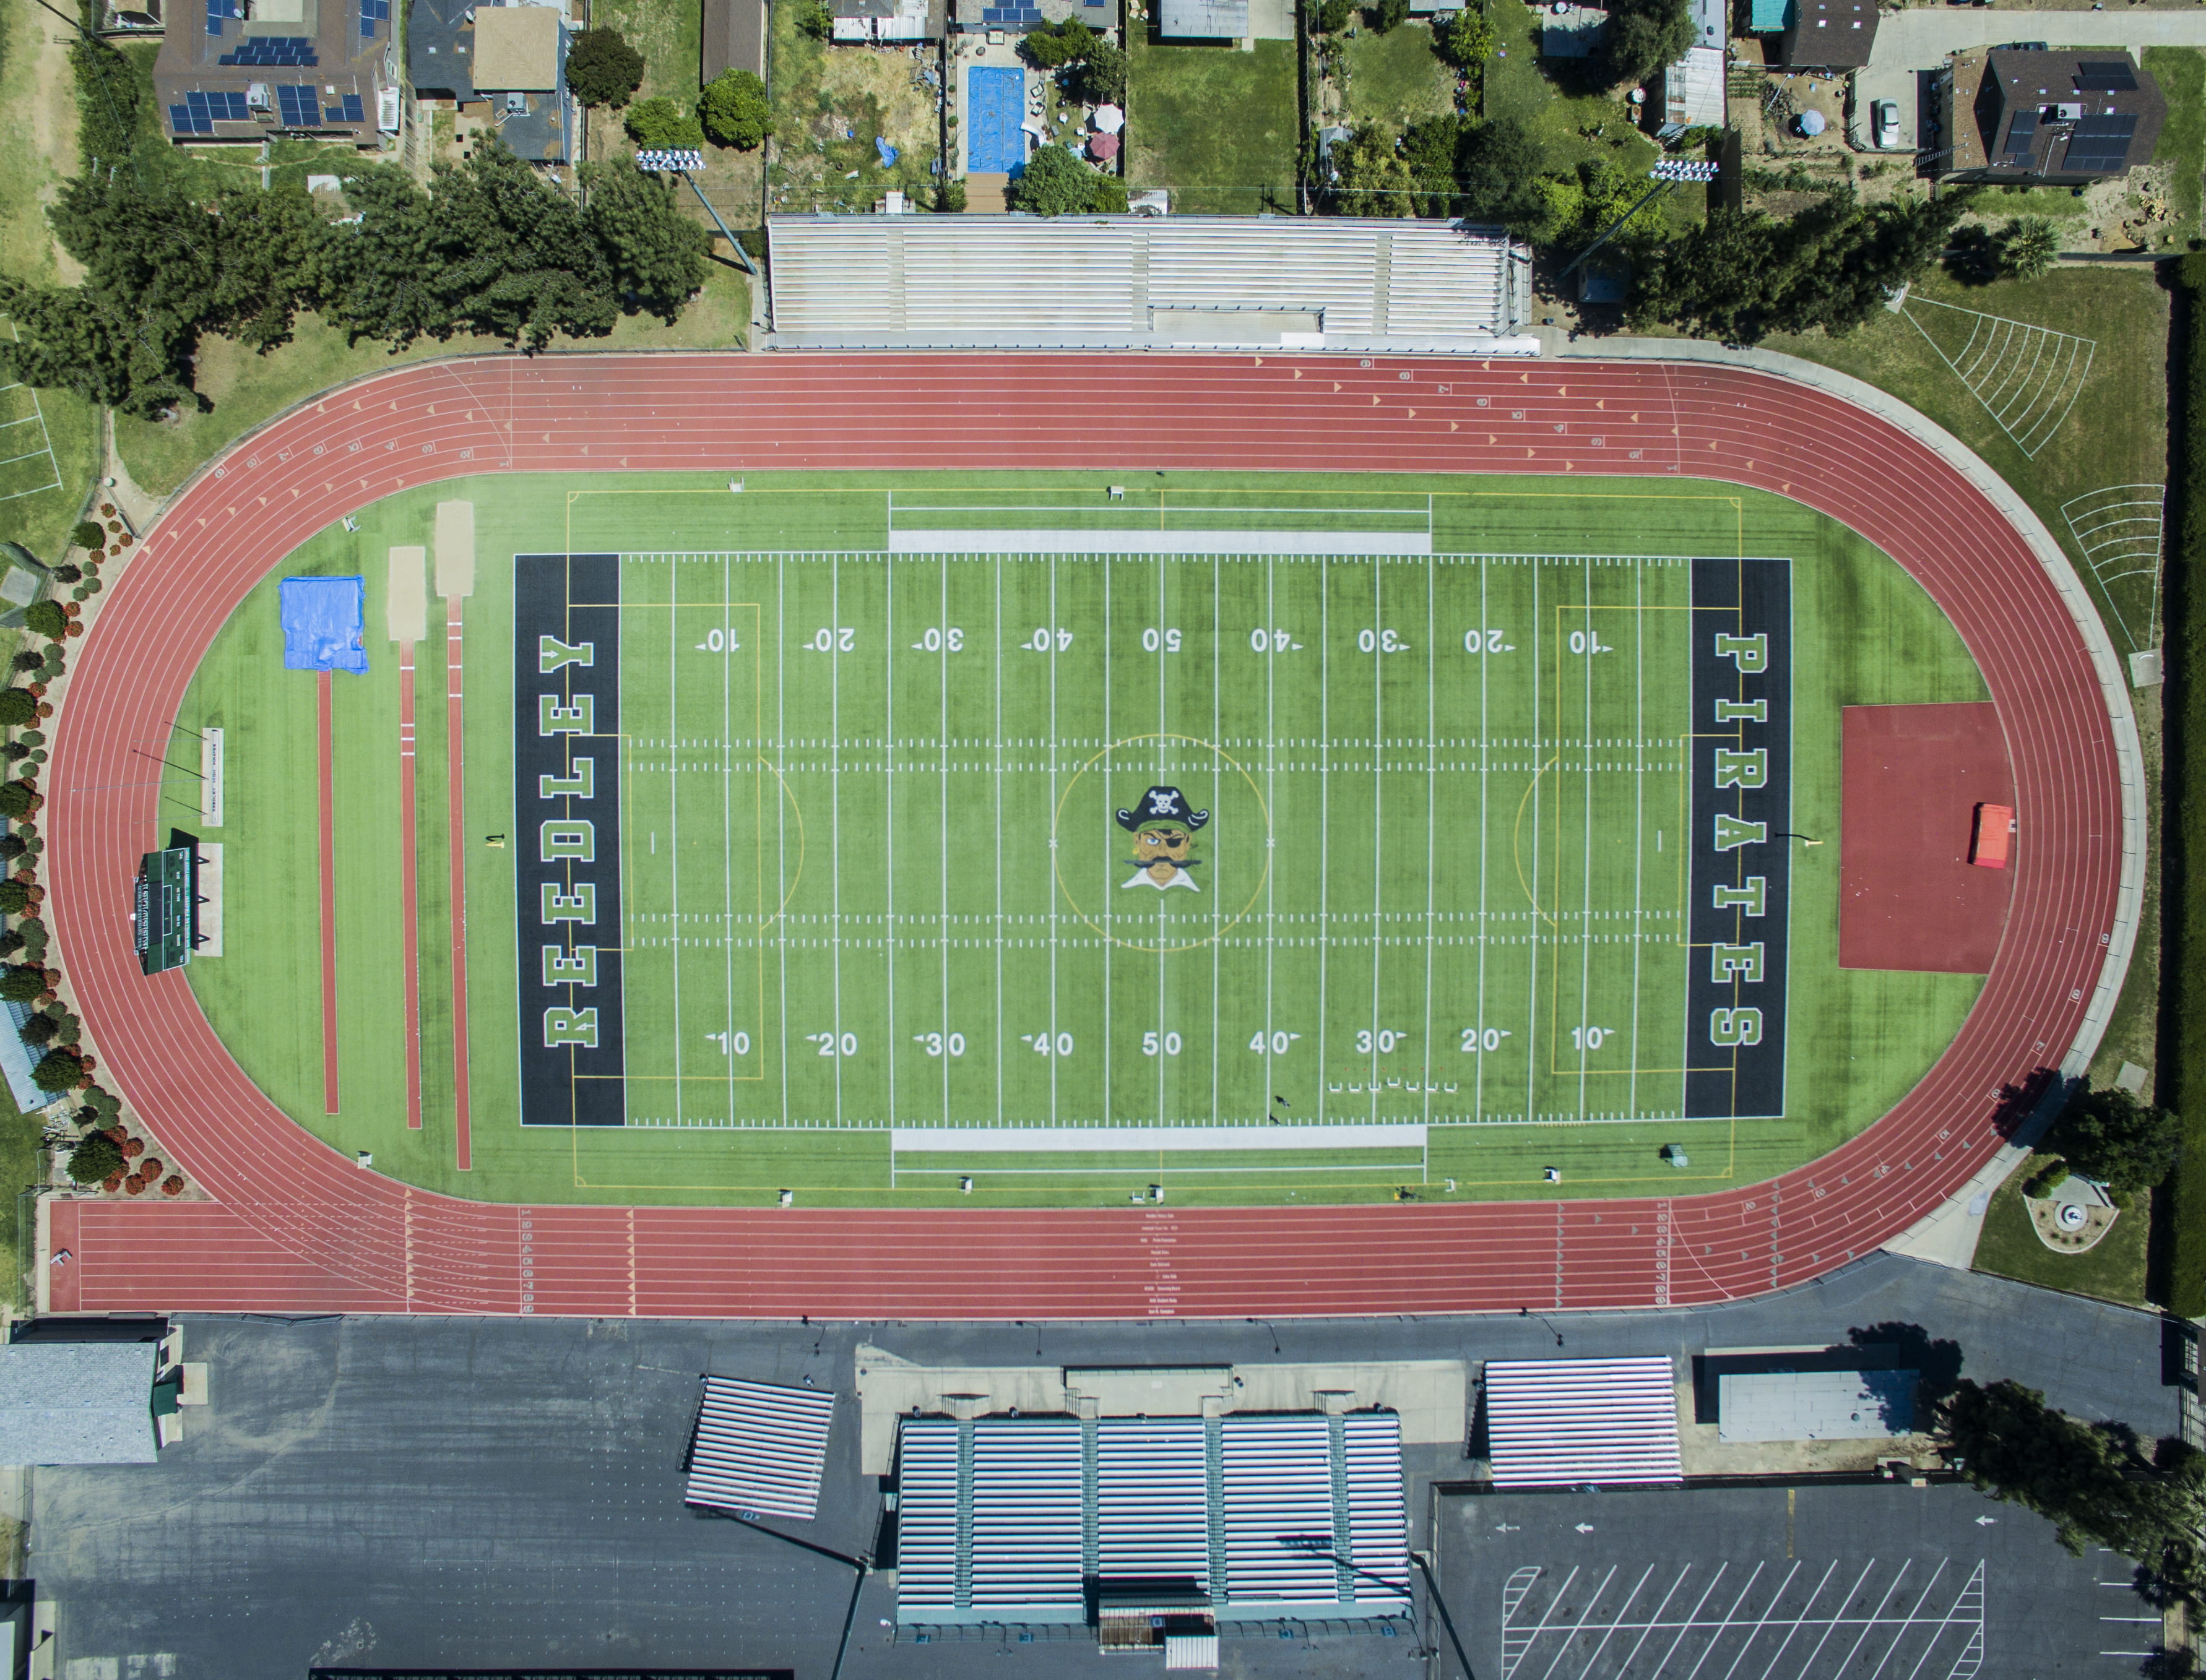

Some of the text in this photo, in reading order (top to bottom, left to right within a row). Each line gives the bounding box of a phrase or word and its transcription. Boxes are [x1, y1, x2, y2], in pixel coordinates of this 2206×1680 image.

[278, 452, 288, 461] 7
[313, 444, 323, 455] 6
[348, 442, 359, 452] 5
[384, 441, 394, 450] 4
[422, 444, 432, 453] 3
[460, 450, 471, 460] 2
[214, 468, 225, 478] 9
[246, 458, 257, 468] 8
[709, 628, 740, 652] 10
[816, 628, 855, 652] 20
[925, 628, 964, 652] 30
[1034, 629, 1073, 652] 40
[1143, 629, 1182, 652] 50
[1251, 629, 1290, 652] 40
[1359, 629, 1398, 653] 30
[1464, 630, 1503, 653] 20
[1570, 631, 1603, 654] 10
[539, 635, 598, 1048] REEDLEY
[1710, 633, 1768, 1046] PIRATES
[717, 1032, 750, 1055] 10
[818, 1032, 857, 1056] 20
[926, 1032, 965, 1056] 30
[1034, 1032, 1073, 1056] 40
[1143, 1032, 1182, 1056] 50
[1249, 1031, 1288, 1055] 40
[1356, 1030, 1395, 1053] 30
[1461, 1029, 1499, 1052] 20
[1572, 1027, 1603, 1049] 10
